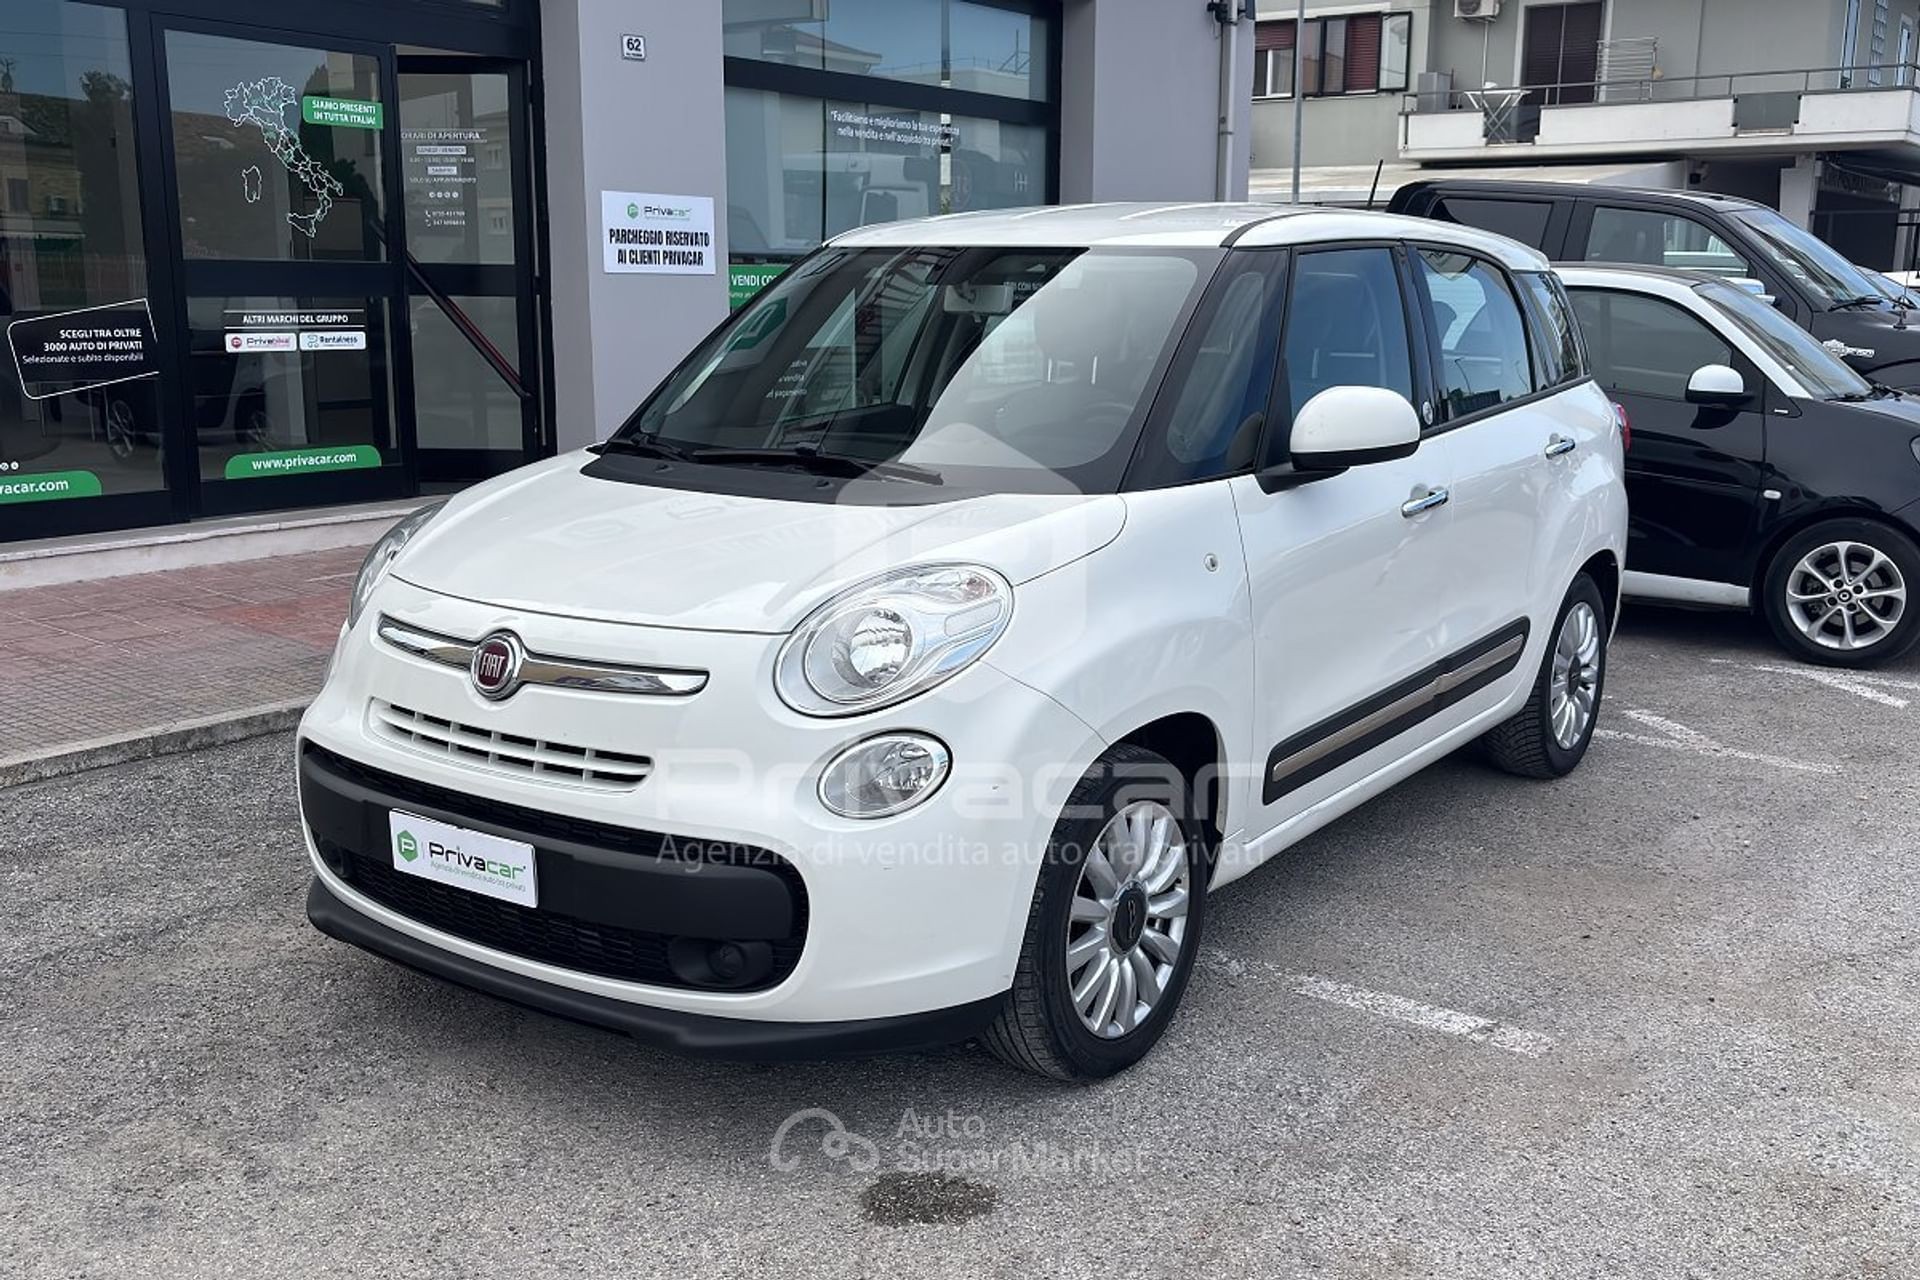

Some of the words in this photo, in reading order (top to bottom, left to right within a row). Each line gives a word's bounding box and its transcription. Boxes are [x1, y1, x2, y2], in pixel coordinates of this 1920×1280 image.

[627, 38, 641, 51] 62
[312, 100, 339, 111] SIAMO
[340, 102, 376, 114] PRESENTI
[313, 111, 323, 121] IN
[324, 112, 349, 122] TUTTA
[438, 131, 480, 140] APERTURA
[855, 129, 878, 140] vendita
[644, 204, 691, 217] Privacar
[609, 228, 663, 246] PARCHEGGIO
[665, 230, 711, 247] RISERVATO
[617, 249, 627, 264] AI
[629, 249, 661, 265] CLIENTI
[662, 250, 704, 266] PRIVACAR
[731, 274, 760, 286] VENDI
[242, 315, 265, 324] ALTRI
[266, 314, 299, 324] MARCHI
[300, 314, 316, 323] DEL
[316, 314, 348, 323] GRUPPO
[59, 329, 92, 339] SCEGLI
[93, 329, 112, 338] TRA
[113, 328, 142, 338] OLTRE
[43, 342, 67, 351] 3000
[68, 342, 96, 351] AUTO
[97, 342, 107, 350] DI
[108, 341, 143, 350] PRIVATI
[22, 354, 70, 364] Selezionate
[77, 353, 102, 363] subito
[103, 352, 144, 363] disponibili
[252, 452, 357, 470] www.privacar.com
[480, 653, 505, 678] FIAT
[428, 842, 524, 879] Privacar
